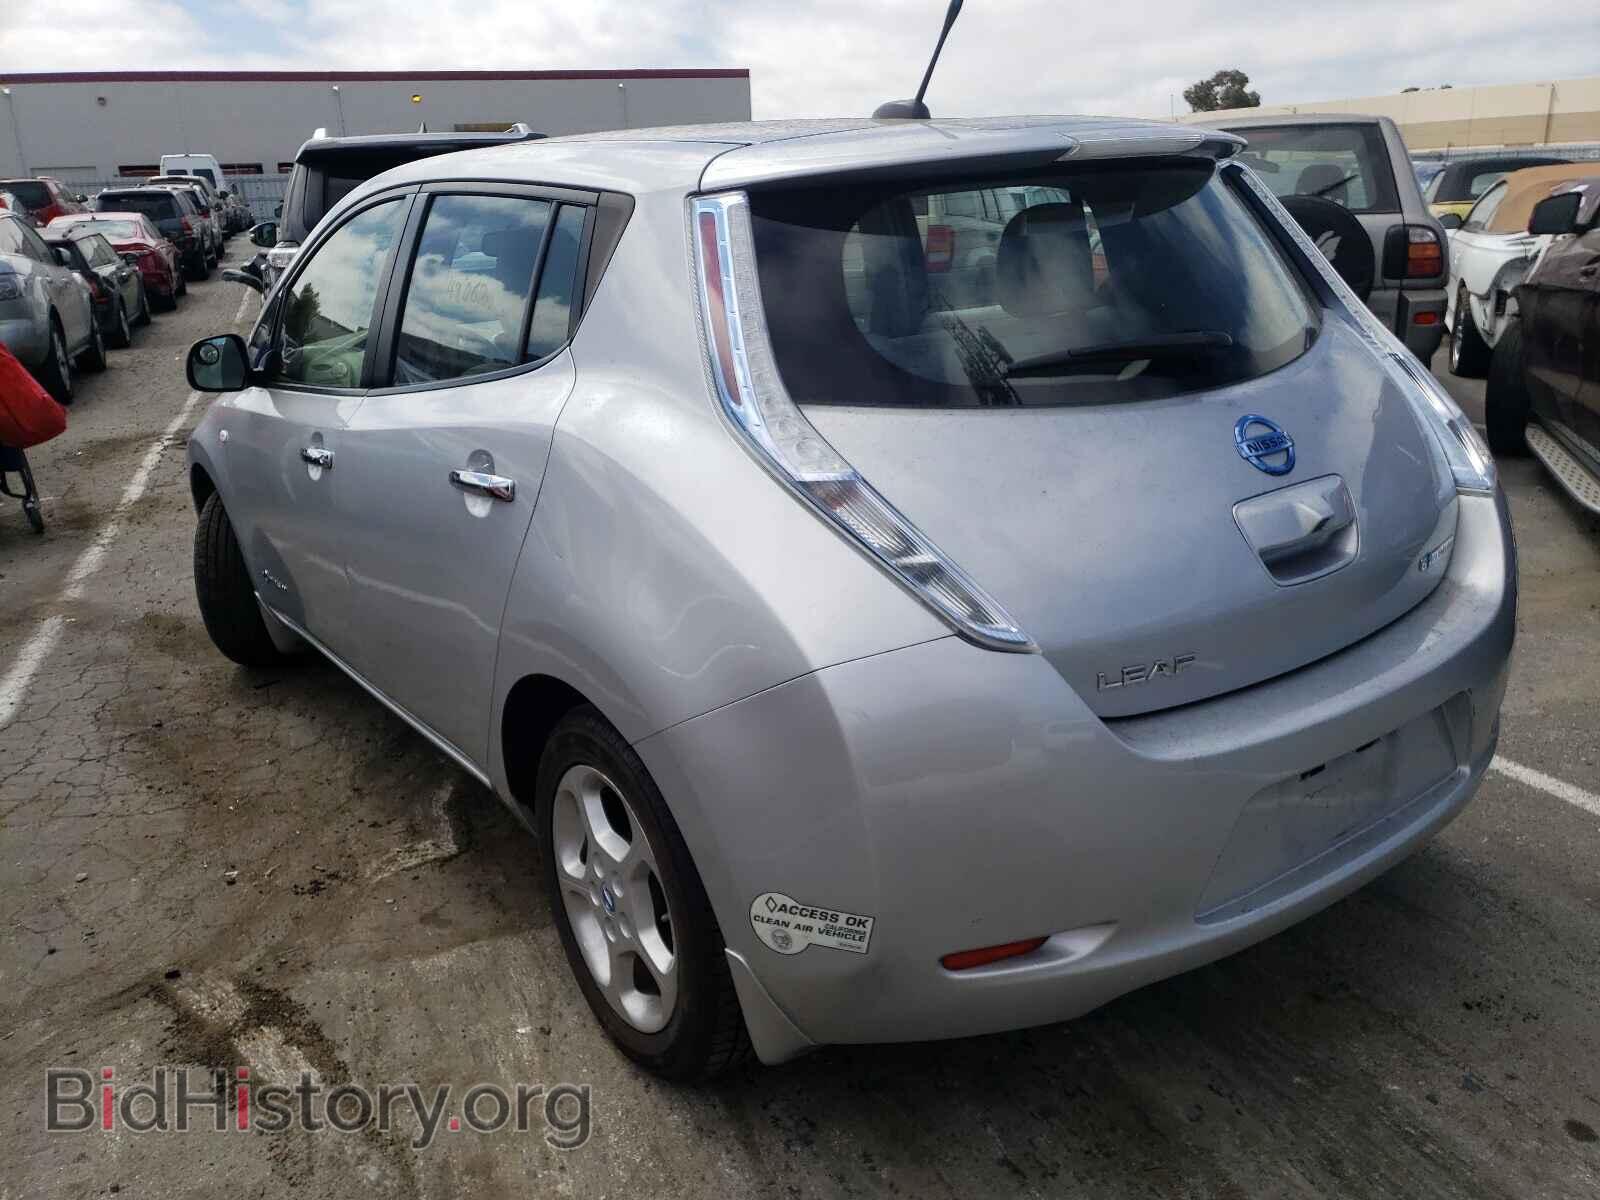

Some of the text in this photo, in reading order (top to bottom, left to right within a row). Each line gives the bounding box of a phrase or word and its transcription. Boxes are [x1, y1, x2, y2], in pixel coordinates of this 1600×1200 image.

[1245, 431, 1290, 453] NISSAN
[1097, 653, 1195, 692] LEAF
[753, 915, 866, 943] CLEAN AIR VEHICLE
[777, 903, 870, 929] ACCESS OK
